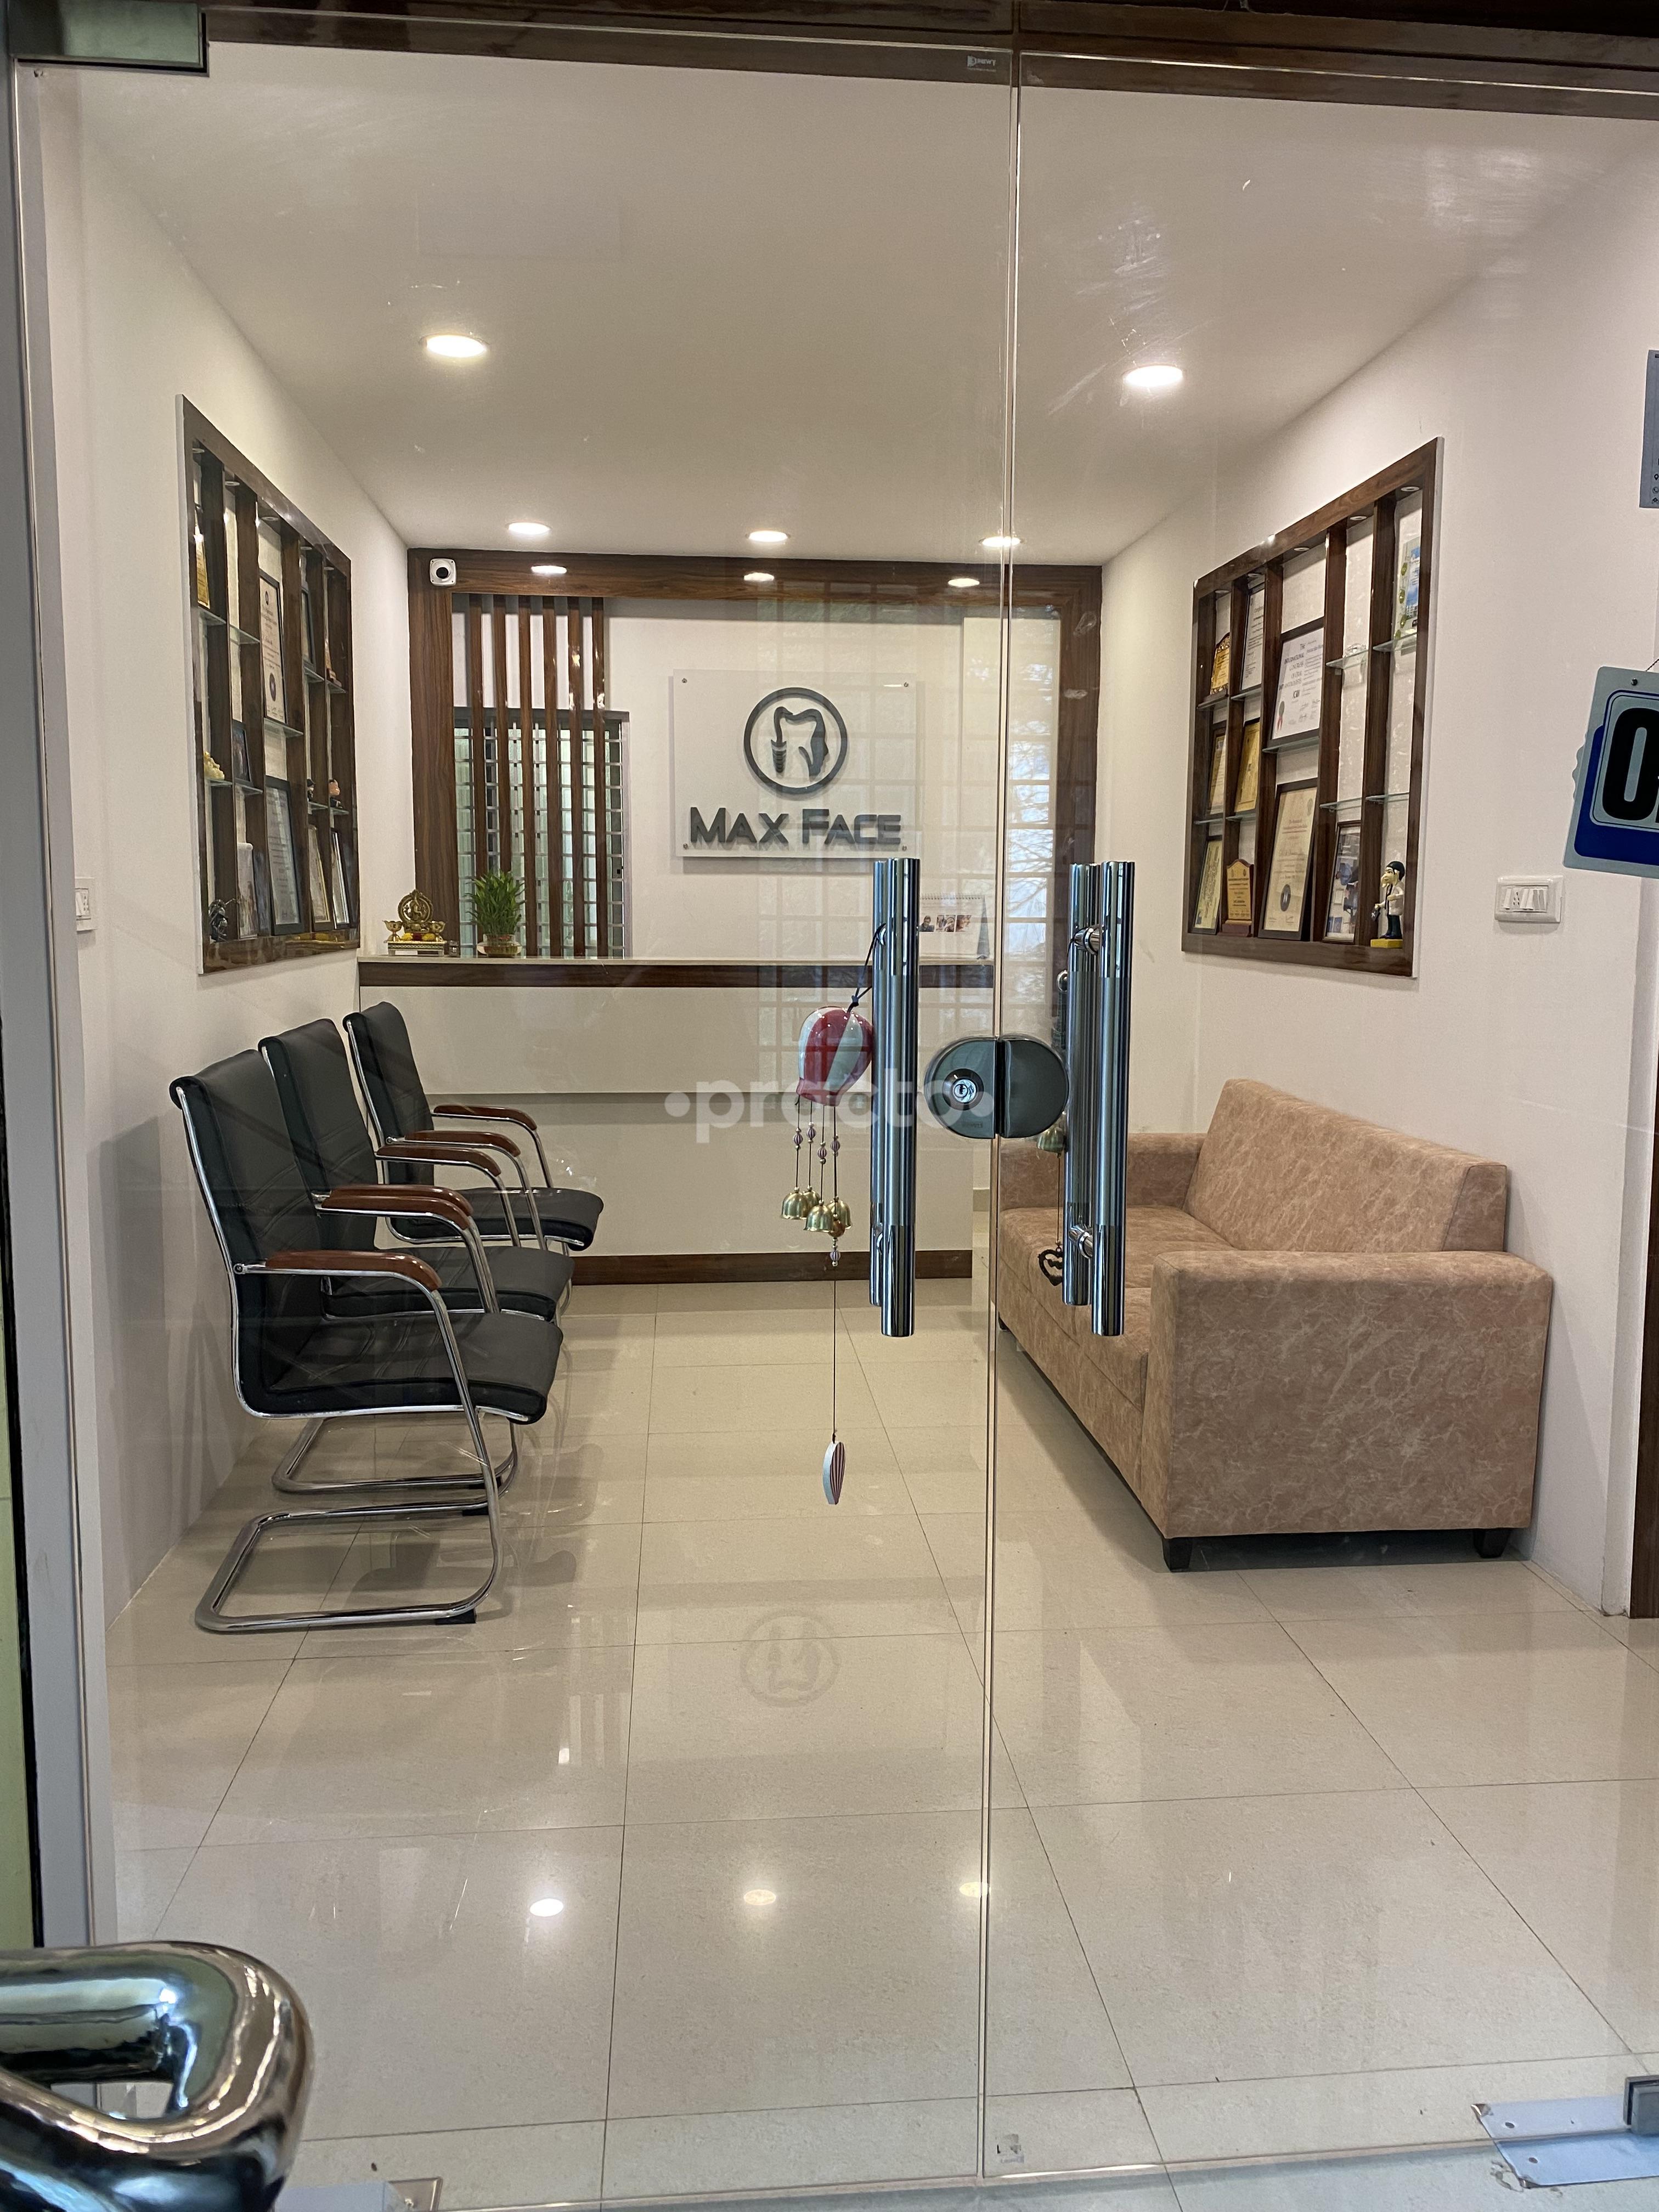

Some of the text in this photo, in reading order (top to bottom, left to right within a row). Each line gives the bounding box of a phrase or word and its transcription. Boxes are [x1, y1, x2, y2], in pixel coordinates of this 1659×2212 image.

[1602, 707, 1659, 823] O
[690, 806, 901, 844] MAX FACE
